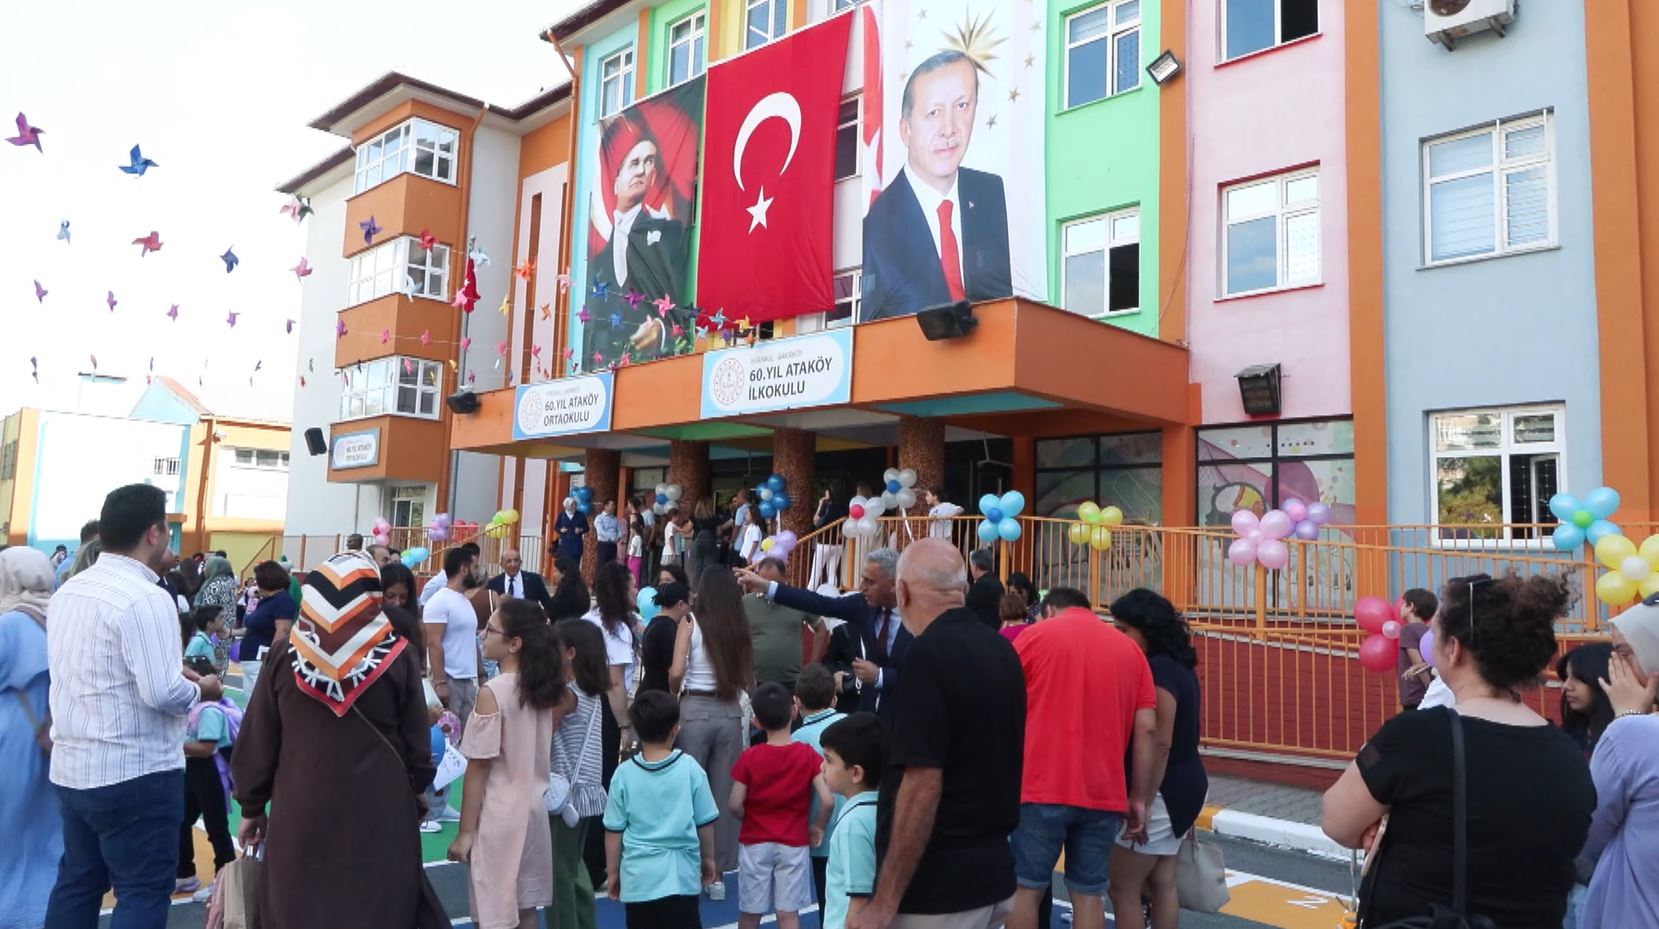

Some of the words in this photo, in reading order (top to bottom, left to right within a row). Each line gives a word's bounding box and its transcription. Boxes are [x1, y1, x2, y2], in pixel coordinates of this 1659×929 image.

[749, 365, 783, 382] 60.YIL
[786, 356, 832, 377] ATAKÖY
[748, 380, 805, 401] İLKOKULU
[545, 399, 567, 411] 60.YIL
[569, 393, 599, 407] ATAKÖY
[543, 410, 590, 427] ORTAOKULU
